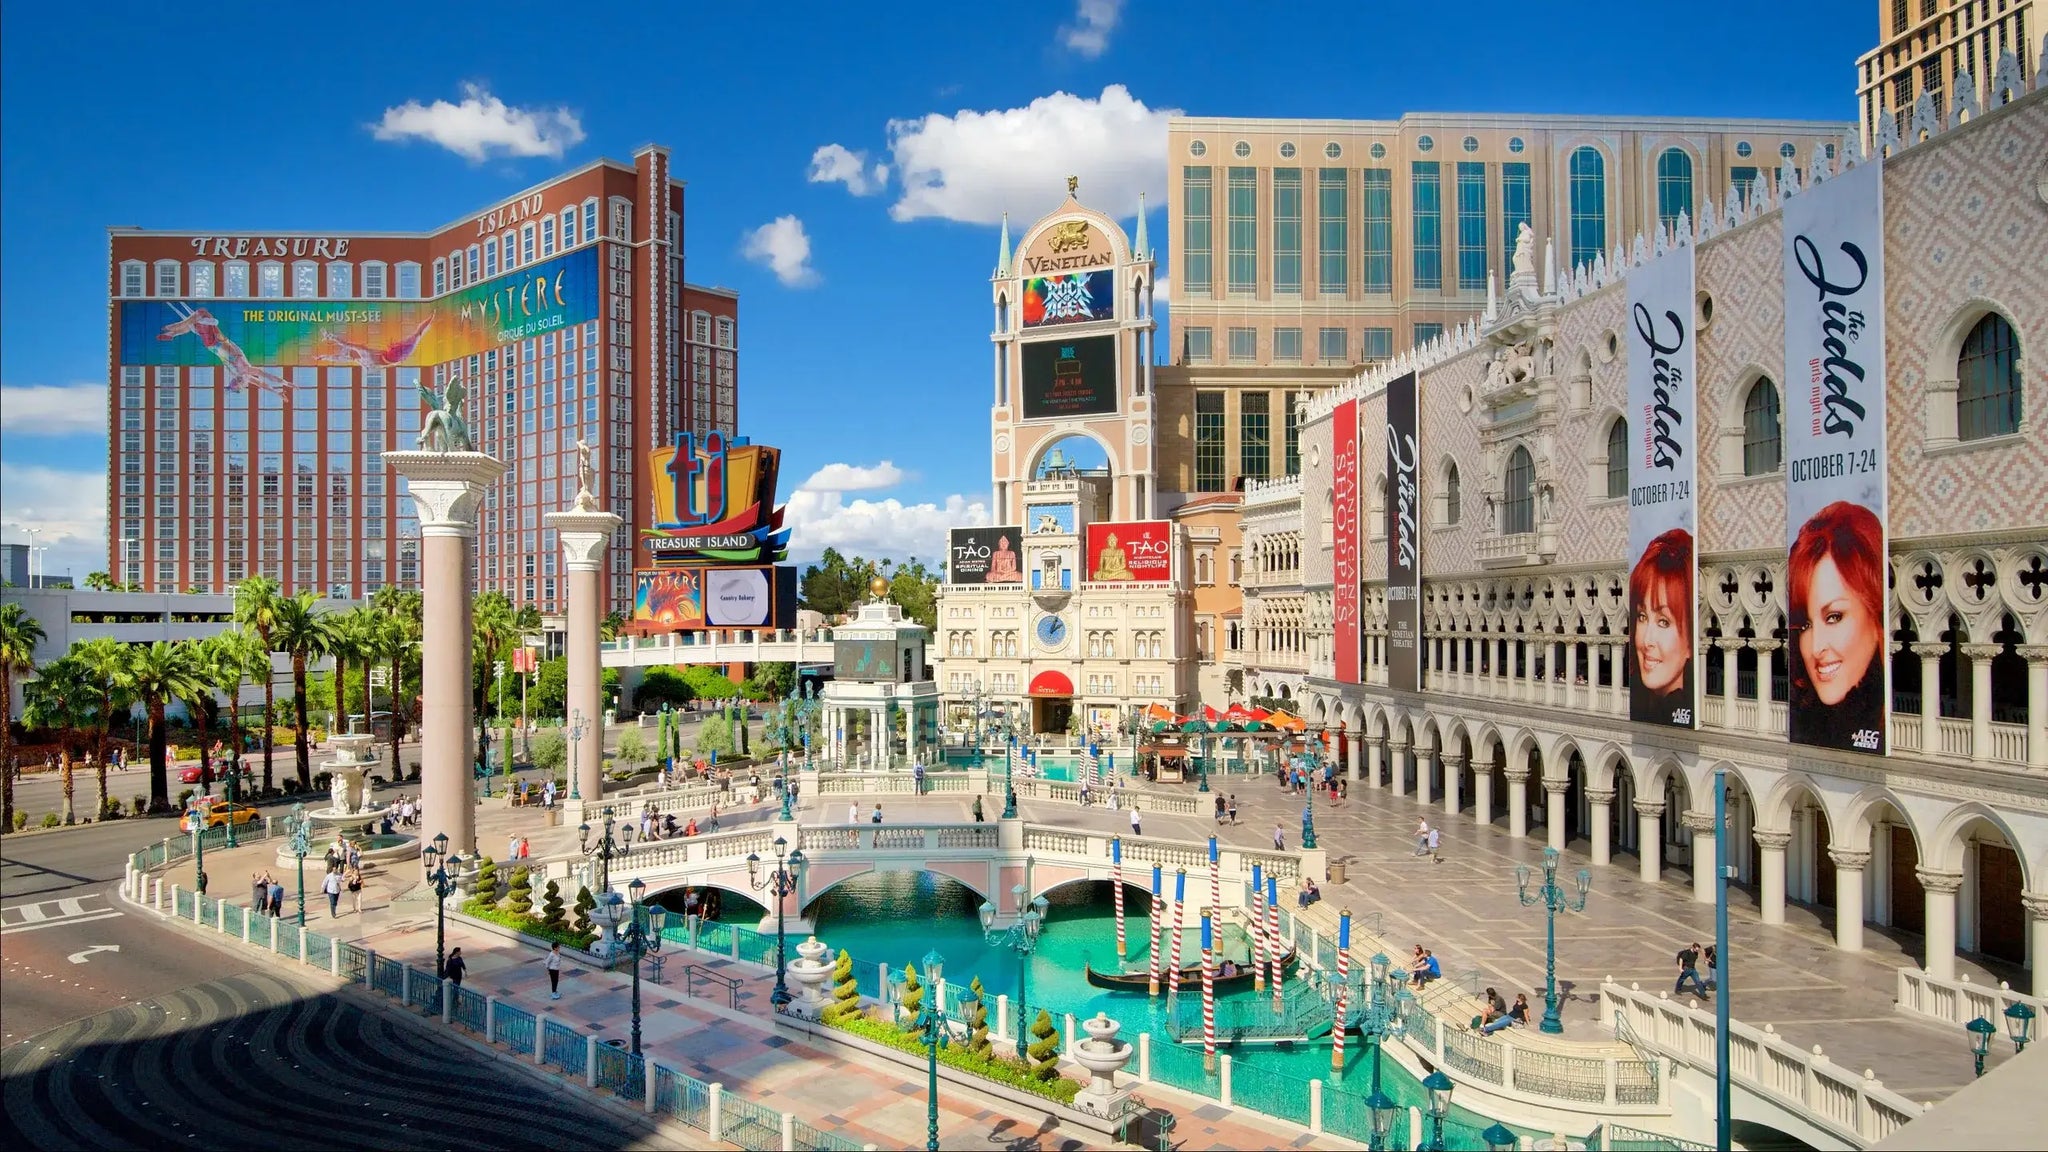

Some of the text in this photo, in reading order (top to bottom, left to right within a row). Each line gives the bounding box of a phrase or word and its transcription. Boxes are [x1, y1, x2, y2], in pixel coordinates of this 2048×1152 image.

[476, 193, 544, 238] ISLAND
[191, 236, 350, 260] TREASURE
[1025, 252, 1112, 274] VENETIAN
[460, 269, 566, 328] MYSTÈRE
[1042, 273, 1094, 305] ROCK
[243, 310, 382, 322] THE ORIGINAL MUST-SEE
[1042, 297, 1095, 322] AGES
[497, 314, 565, 342] CIRQUE DU SOLEIL
[1848, 309, 1866, 345] the
[1670, 366, 1683, 394] the
[1809, 358, 1822, 436] girls night out
[665, 430, 726, 526] ti
[1792, 449, 1877, 483] OCTOBER 7-24
[1631, 480, 1689, 507] OCTOBER 7-24
[650, 535, 748, 549] TREASURE ISLAND
[1126, 540, 1169, 555] TAO
[1336, 453, 1347, 622] SHOPPES
[1347, 439, 1356, 637] GRAND CANAL
[953, 545, 991, 560] TAO
[1388, 586, 1417, 600] OCTOBER 7-24
[1673, 708, 1691, 720] AEG
[1854, 729, 1879, 744] AEG
